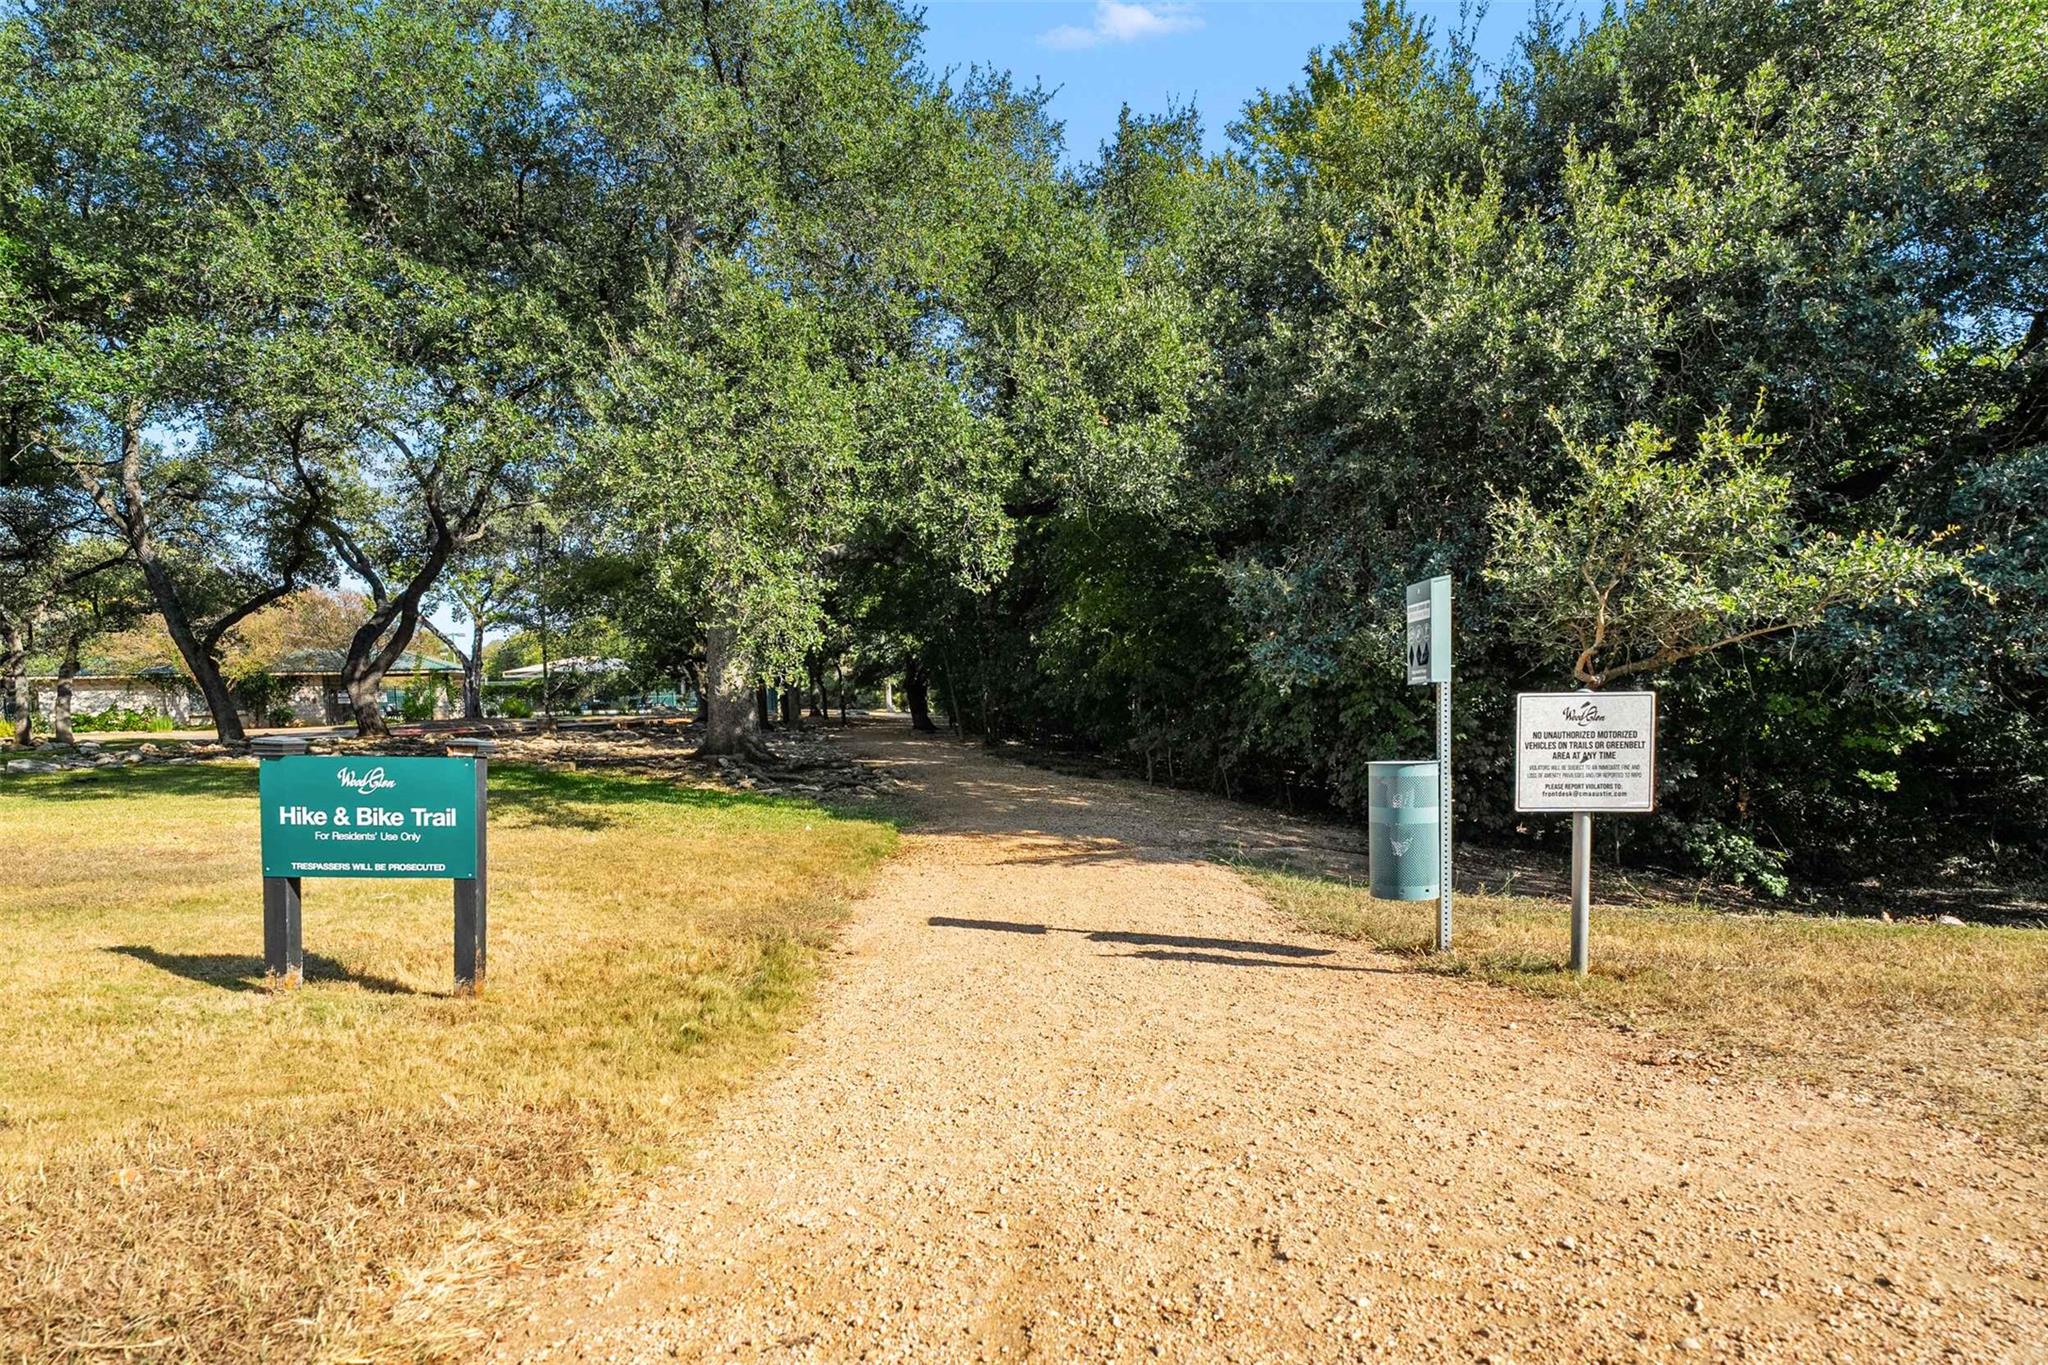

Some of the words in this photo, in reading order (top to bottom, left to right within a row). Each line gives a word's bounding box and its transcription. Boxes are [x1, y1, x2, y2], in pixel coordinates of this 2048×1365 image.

[1532, 731, 1542, 740] NO
[1543, 731, 1596, 739] UNAUTHORIZED
[1597, 730, 1638, 739] MOTORIZED
[1525, 742, 1557, 750] VEHICLES
[1558, 742, 1568, 750] ON
[1569, 741, 1593, 750] TRAILS
[1594, 741, 1604, 749] OR
[1606, 741, 1646, 749] GREENBELT
[1552, 752, 1570, 760] AREA
[1572, 752, 1580, 760] AT
[1582, 751, 1598, 760] ANY
[1599, 751, 1617, 759] TIME
[279, 806, 327, 826] Hike
[333, 806, 349, 826] &
[356, 806, 404, 826] Bike
[410, 807, 456, 827] Trail
[315, 831, 329, 841] For
[380, 832, 398, 841] Use
[401, 832, 421, 843] Only
[291, 862, 350, 871] TRESPASSERS
[352, 862, 373, 871] WILL
[374, 863, 386, 871] BE
[388, 863, 446, 872] PROSECUTED
